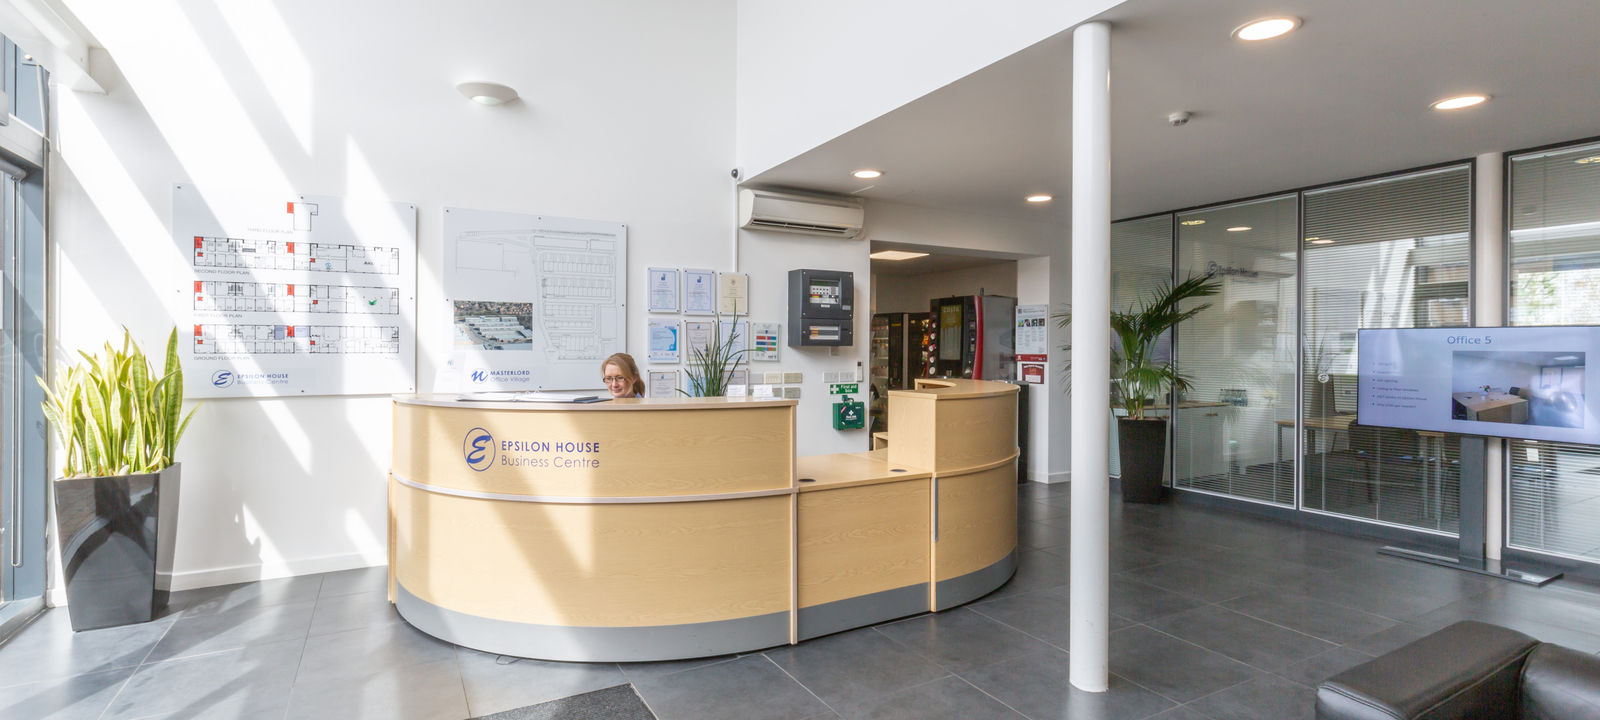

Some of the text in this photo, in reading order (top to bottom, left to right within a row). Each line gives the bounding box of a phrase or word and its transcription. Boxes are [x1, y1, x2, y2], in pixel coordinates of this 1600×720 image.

[1447, 335, 1492, 344] Office 5
[501, 440, 600, 453] EPSILON HOUSE
[501, 454, 600, 469] Business Centre
